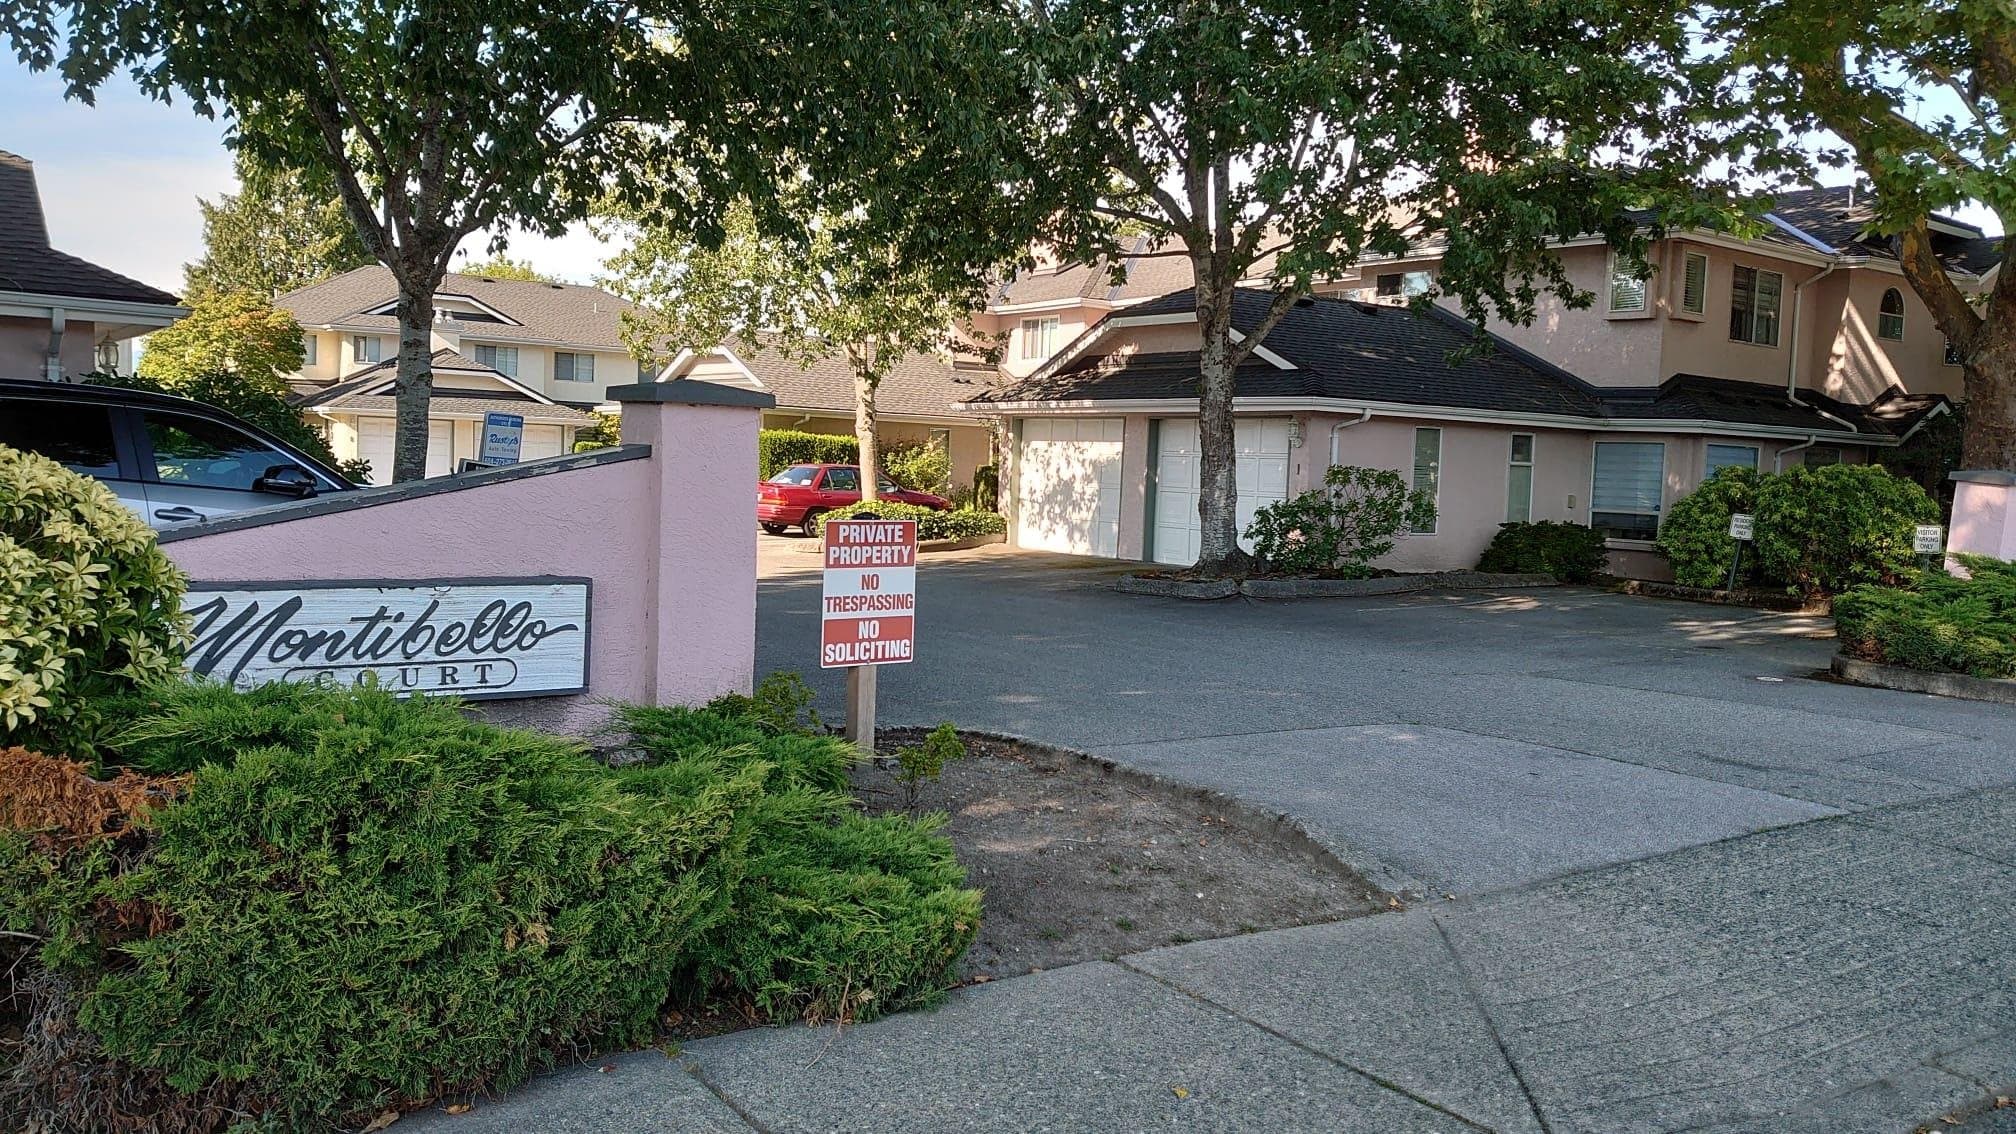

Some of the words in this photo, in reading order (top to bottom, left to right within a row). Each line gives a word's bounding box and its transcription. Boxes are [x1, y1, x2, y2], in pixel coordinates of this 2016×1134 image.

[838, 524, 904, 544] PRIVATE
[829, 545, 912, 565] PROPERTY
[861, 573, 880, 591] NO
[824, 593, 914, 613] TRESPASSING
[180, 594, 579, 685] Montibello
[858, 620, 880, 639] NO
[824, 639, 911, 663] SOLICITING
